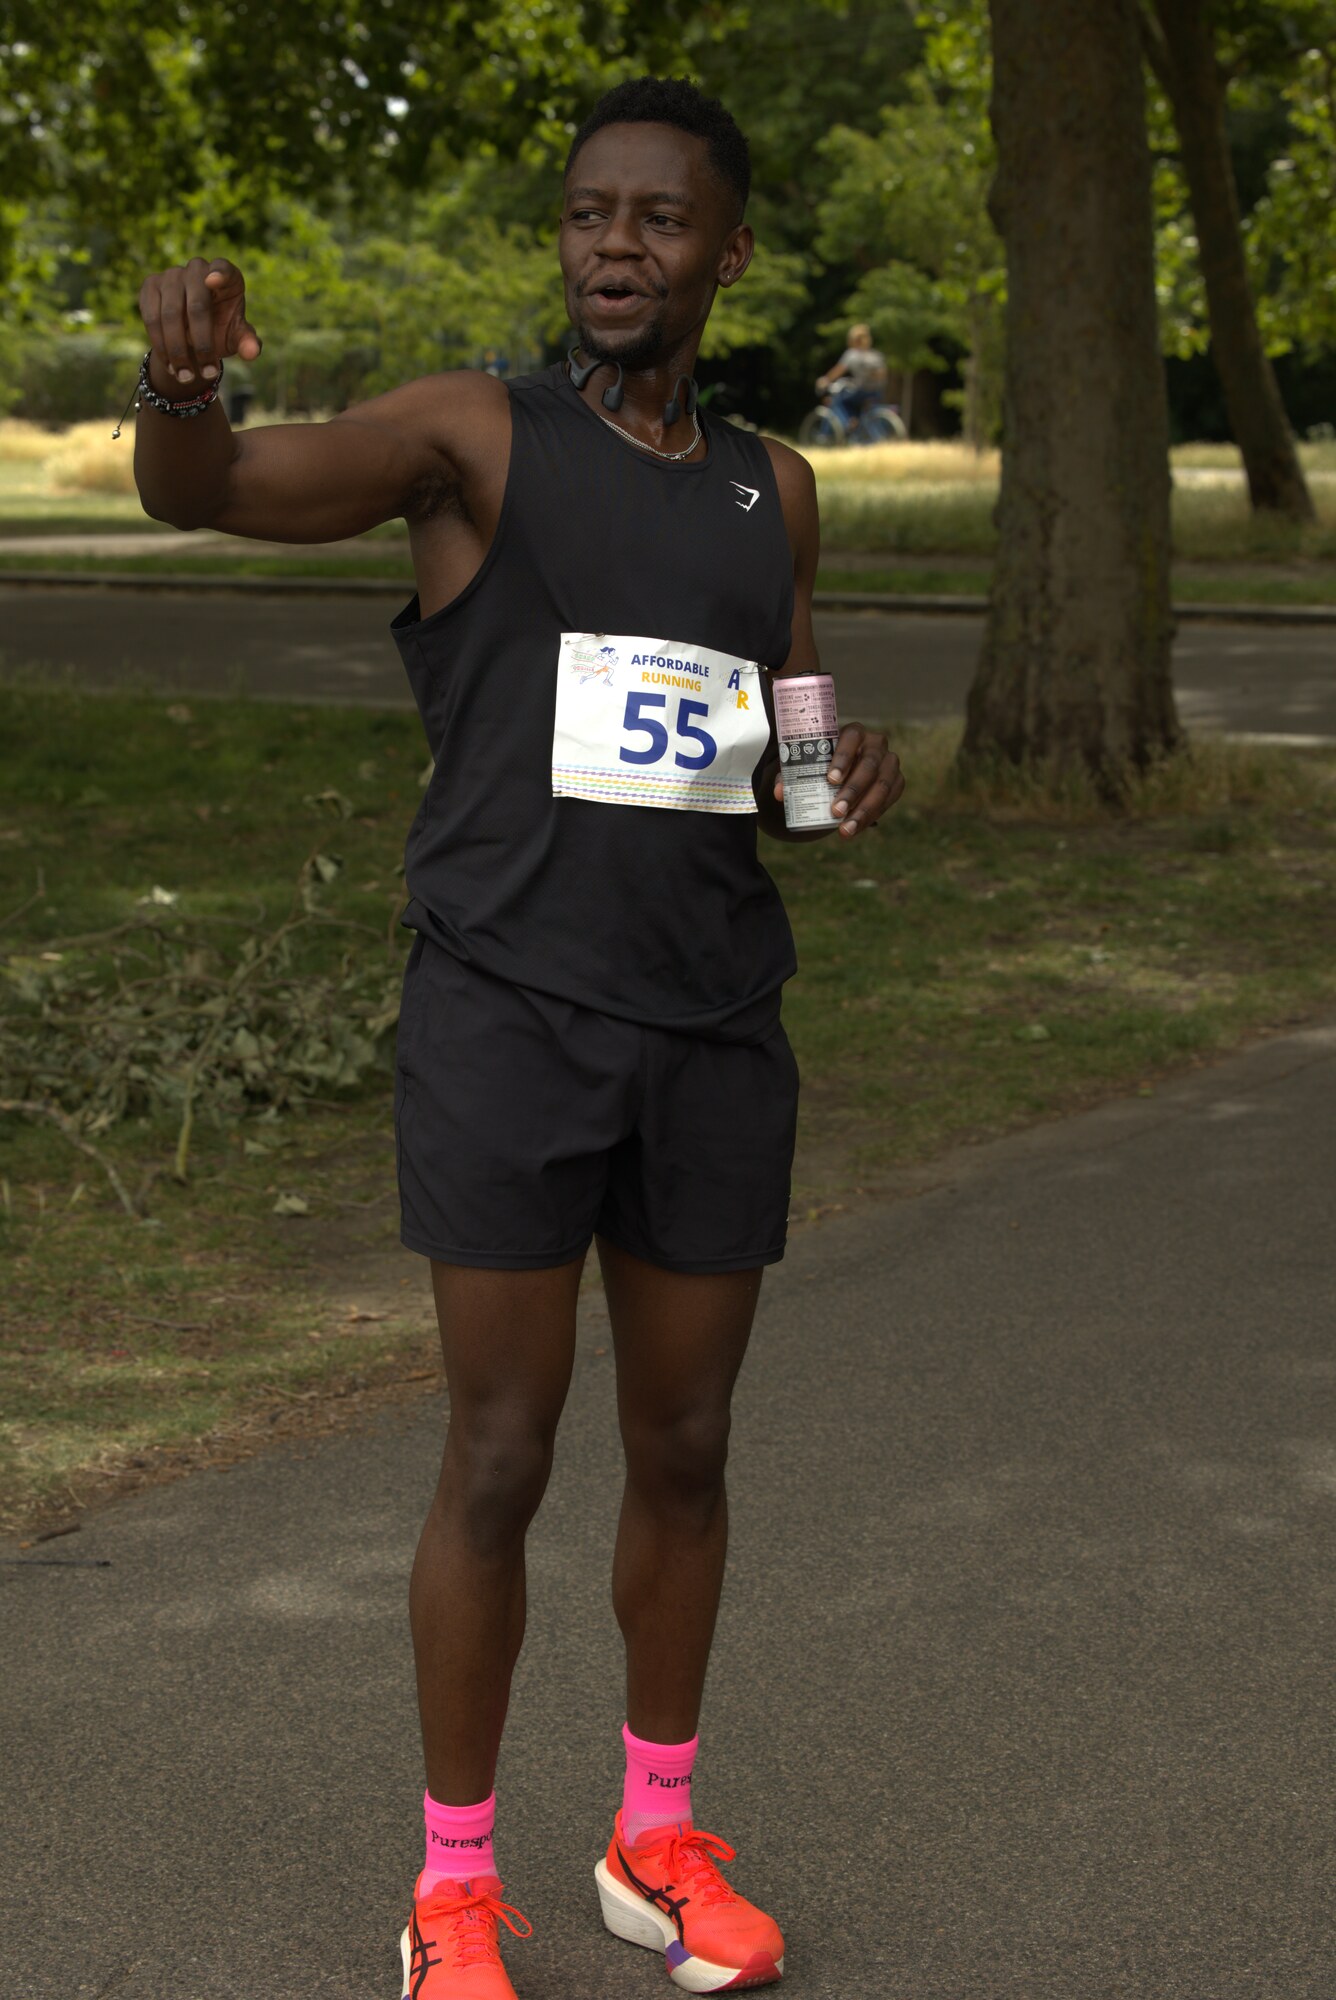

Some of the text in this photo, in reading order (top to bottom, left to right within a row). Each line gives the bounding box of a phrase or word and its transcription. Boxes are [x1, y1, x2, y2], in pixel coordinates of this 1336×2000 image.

[631, 654, 710, 678] AFFORDABLE
[641, 672, 702, 692] RUNNING
[728, 668, 740, 690] A
[736, 690, 750, 710] R
[619, 691, 718, 770] 55
[431, 1826, 494, 1850] Purespo
